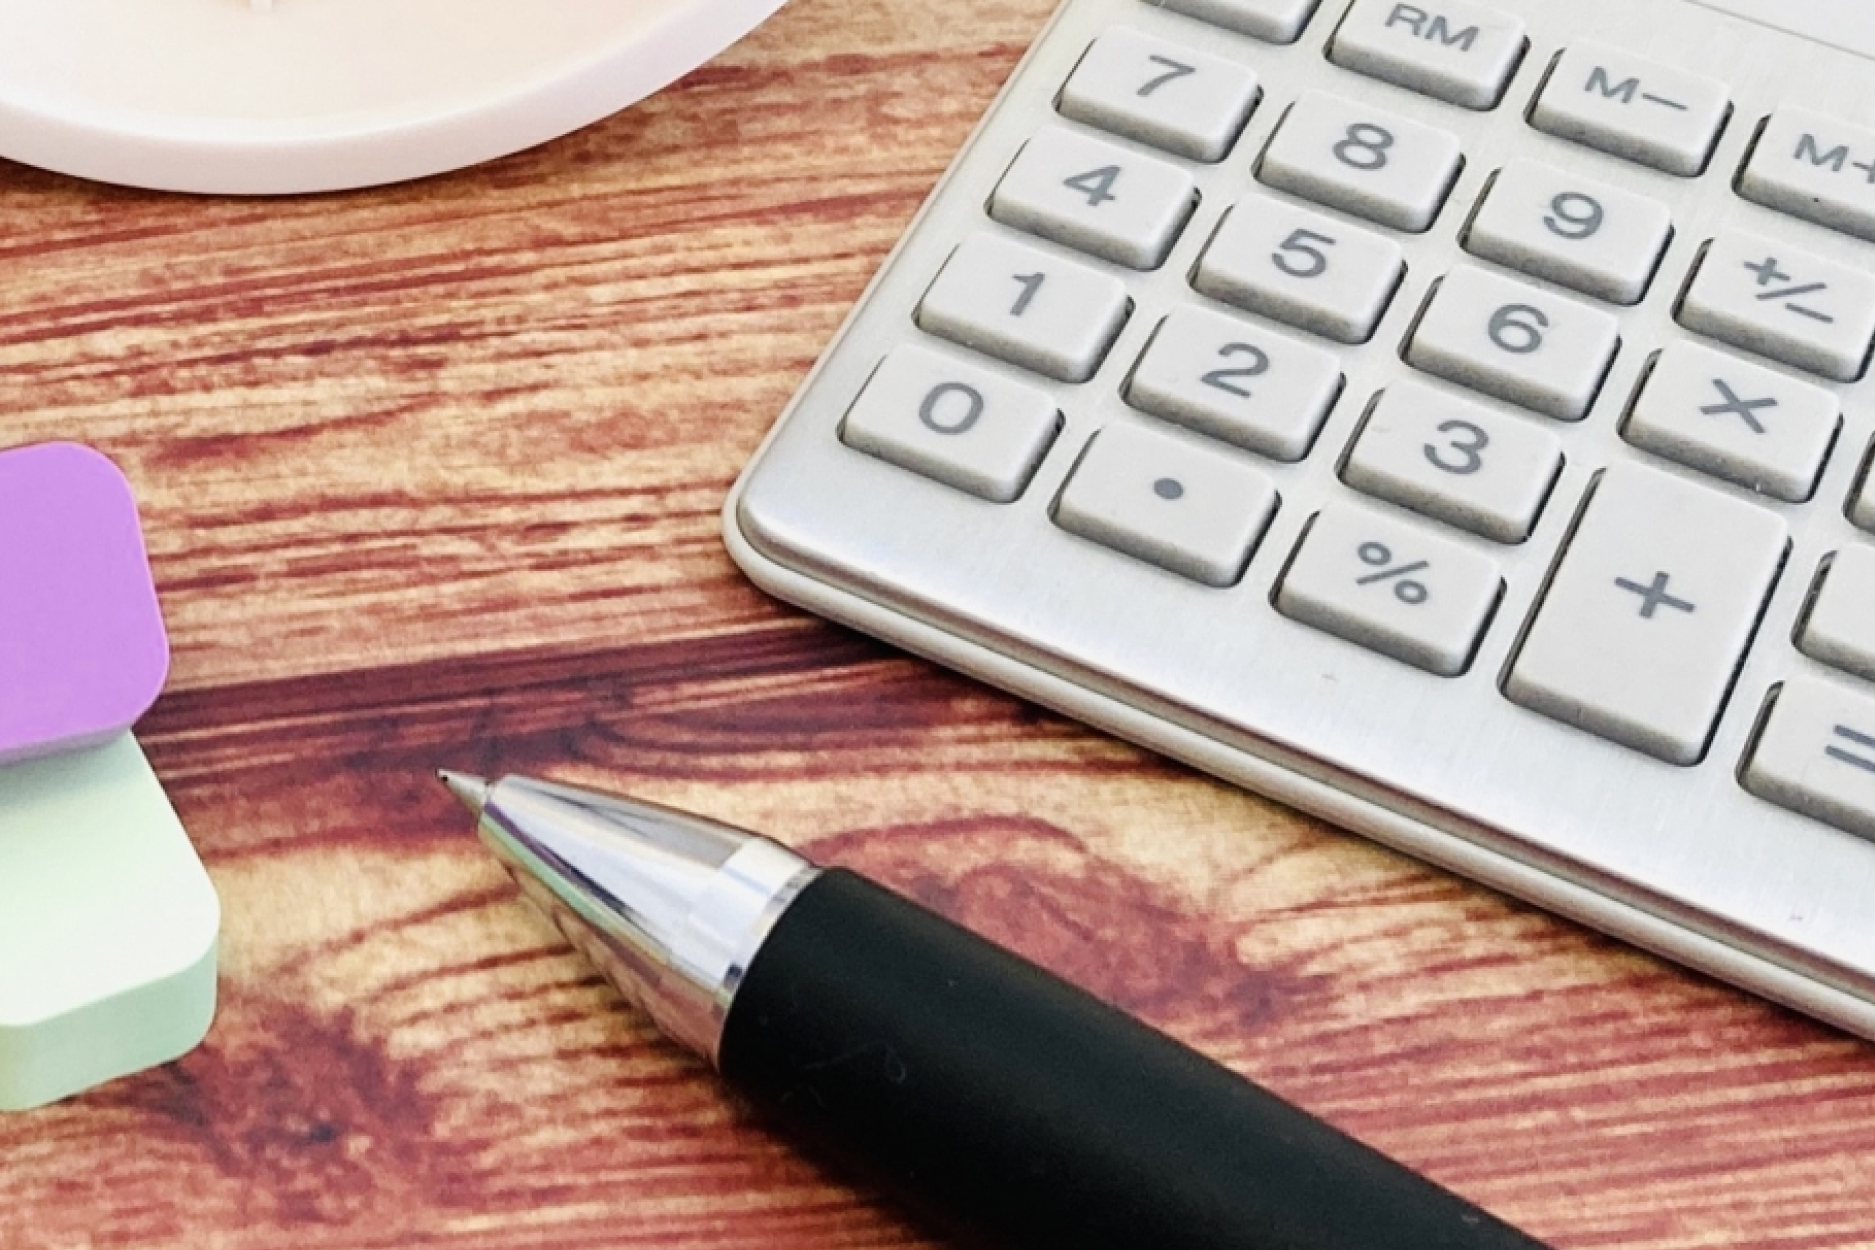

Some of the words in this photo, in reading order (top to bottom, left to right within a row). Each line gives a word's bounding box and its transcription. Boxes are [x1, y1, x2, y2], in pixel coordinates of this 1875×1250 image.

[1383, 1, 1480, 53] RM
[1136, 55, 1197, 97] 7
[1332, 123, 1395, 171] 8
[1063, 165, 1122, 206] 4
[1543, 192, 1605, 240] 9
[1272, 229, 1337, 278] 5
[1010, 272, 1046, 316] 1
[1488, 303, 1549, 354] 6
[1200, 342, 1271, 398] 2
[1424, 420, 1490, 474] 3
[1356, 542, 1429, 606] %
